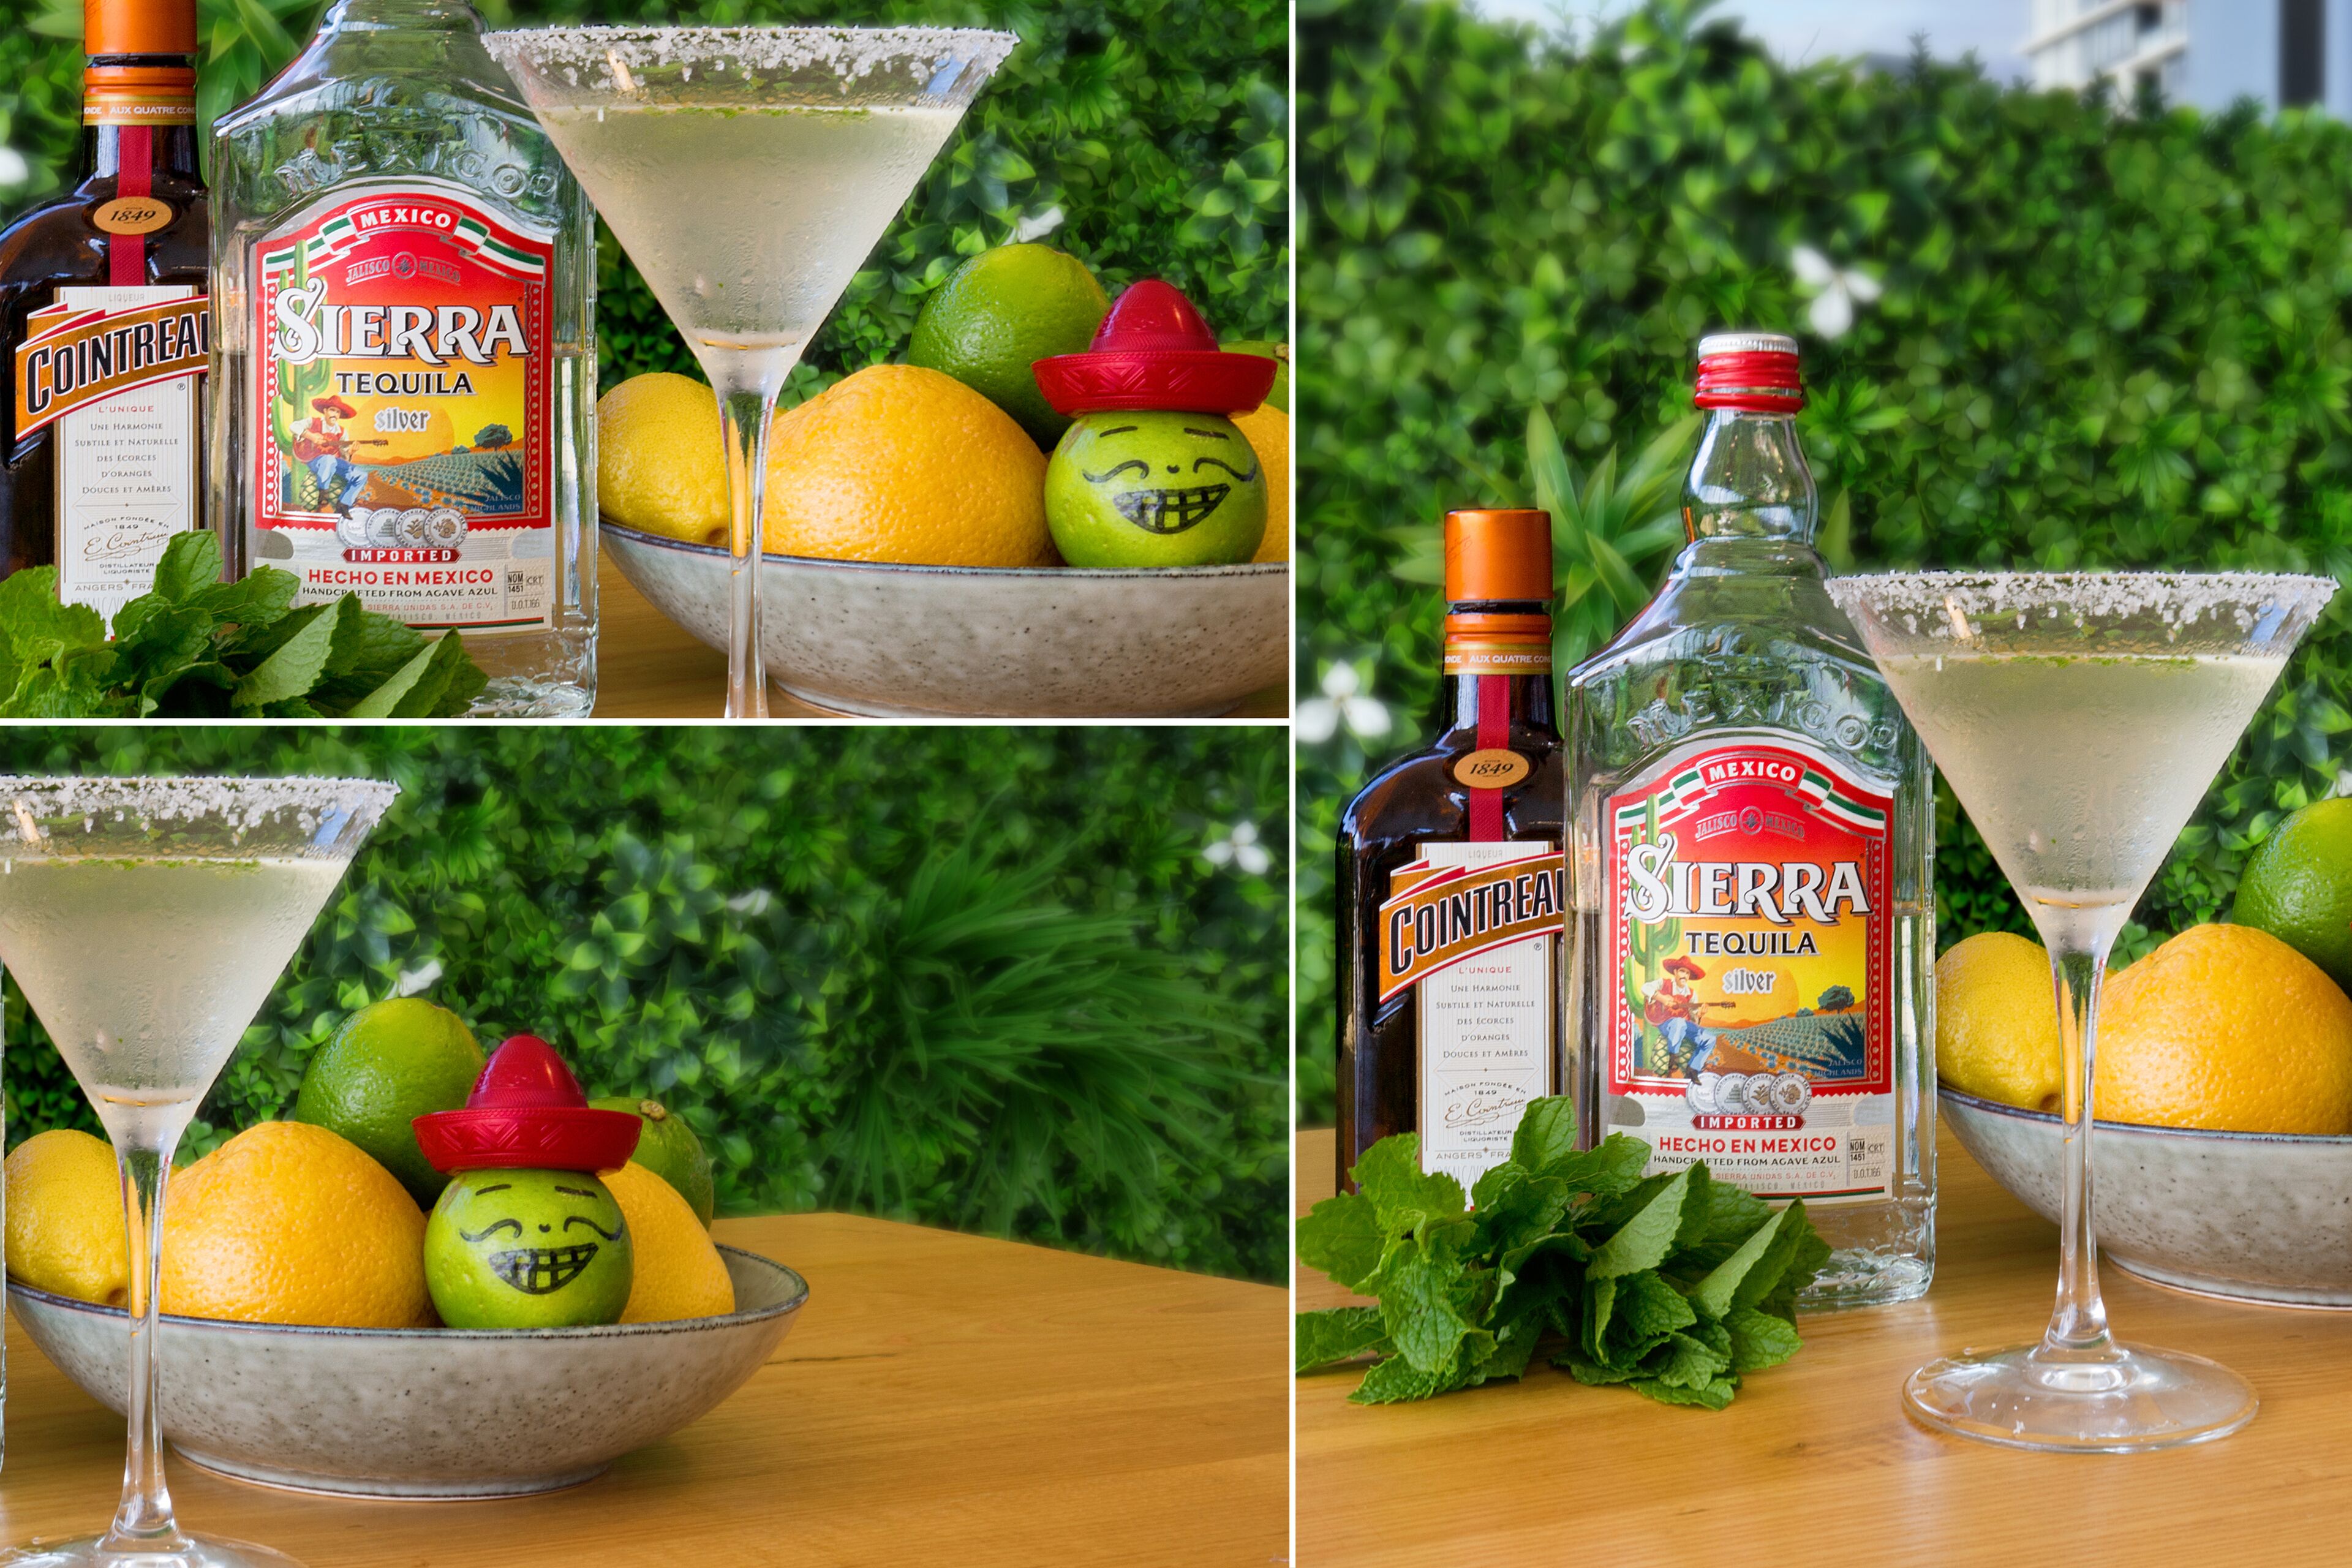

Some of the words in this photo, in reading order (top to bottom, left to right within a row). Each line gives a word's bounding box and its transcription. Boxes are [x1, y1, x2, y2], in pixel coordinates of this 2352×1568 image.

[110, 210, 156, 221] 1849
[360, 209, 451, 228] MEXICO
[345, 259, 390, 282] JALISCO
[419, 262, 460, 282] MEXICO
[108, 293, 145, 302] LIQUEUR
[270, 277, 533, 366] SIERRA
[336, 372, 473, 395] TEQUILA
[375, 407, 431, 432] silver
[84, 518, 116, 530] MAISON
[351, 550, 451, 561] IMPORTED
[309, 570, 378, 585] HECHO
[383, 571, 409, 585] EN
[415, 569, 493, 585] MEXICO
[508, 573, 523, 583] NOM
[303, 587, 386, 597] HANDCRFTED
[1470, 763, 1513, 774] 1849
[1709, 762, 1796, 782] MEXICO
[1695, 814, 1738, 838] JALISCO
[1765, 816, 1804, 838] MEXICO
[1468, 850, 1502, 859] LIQUEUR
[1622, 832, 1874, 925] SIERRA
[1686, 932, 1817, 956] TEQUILA
[1723, 968, 1776, 993] silver
[1445, 1083, 1476, 1096] MAISON
[1700, 1117, 1795, 1128] IMPORTED
[1660, 1137, 1726, 1153] HECHO
[1731, 1139, 1755, 1153] EN
[1762, 1136, 1836, 1153] MEXICO
[1850, 1141, 1864, 1151] NOM
[1654, 1156, 1733, 1166] HANDCRFTED
[1850, 1153, 1864, 1161] 1451
